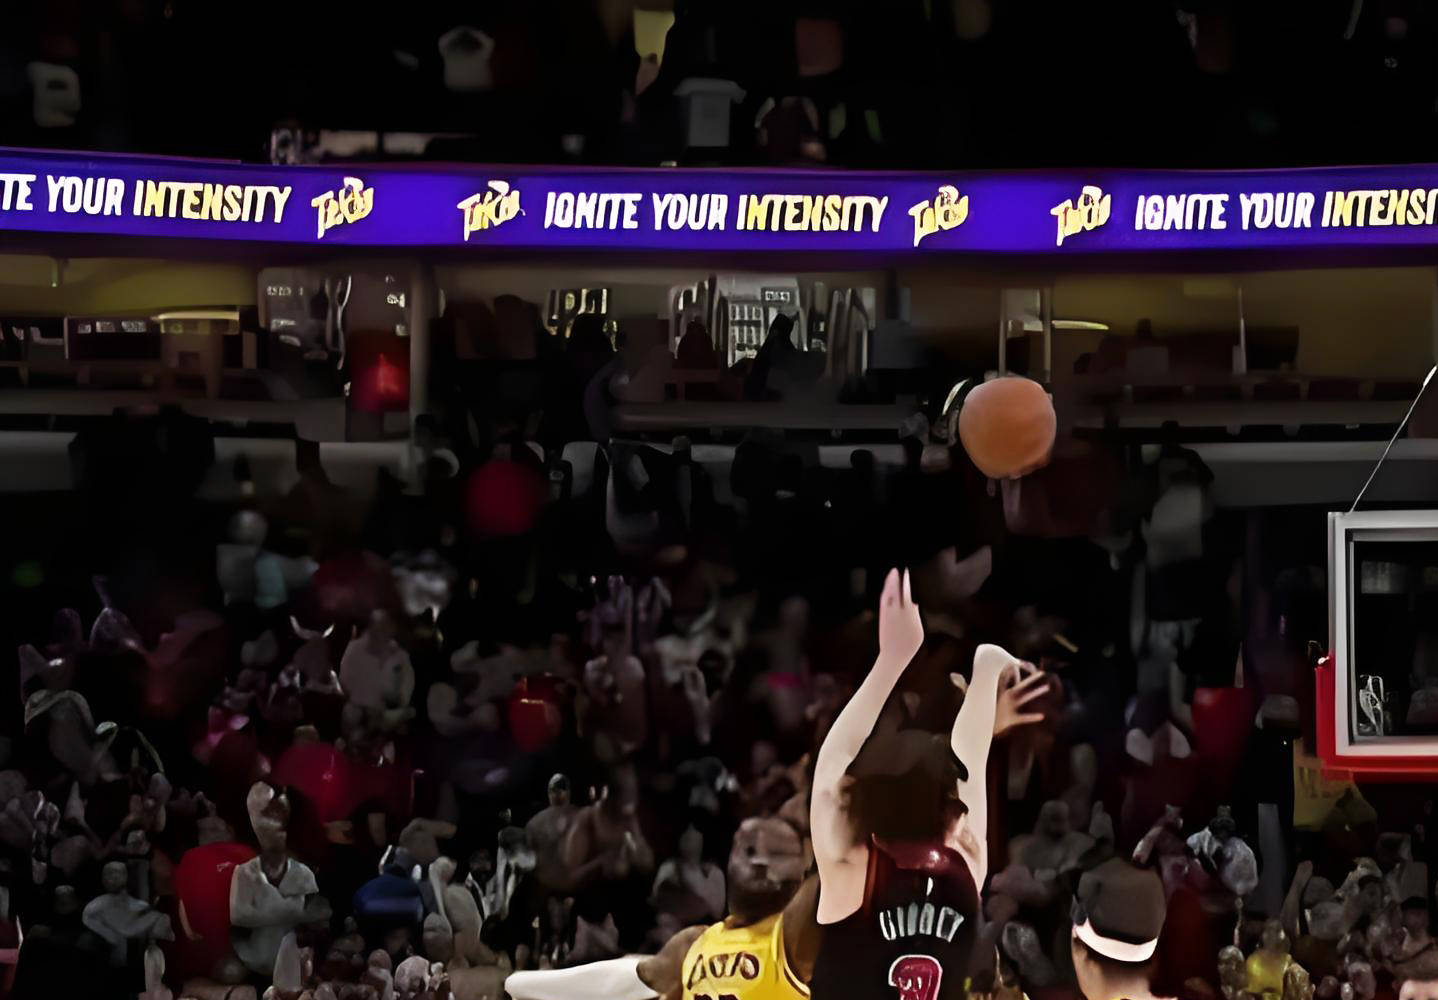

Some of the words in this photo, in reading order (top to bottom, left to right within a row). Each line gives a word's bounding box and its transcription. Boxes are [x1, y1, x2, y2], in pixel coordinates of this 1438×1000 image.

[46, 174, 125, 216] YOUR
[132, 179, 292, 224] INTENSITY
[543, 191, 643, 230] IGNITE
[652, 192, 729, 231] YOUR
[736, 194, 889, 233] INTENSITY
[1134, 193, 1230, 231] IGNITE
[1239, 191, 1316, 231] YOUR
